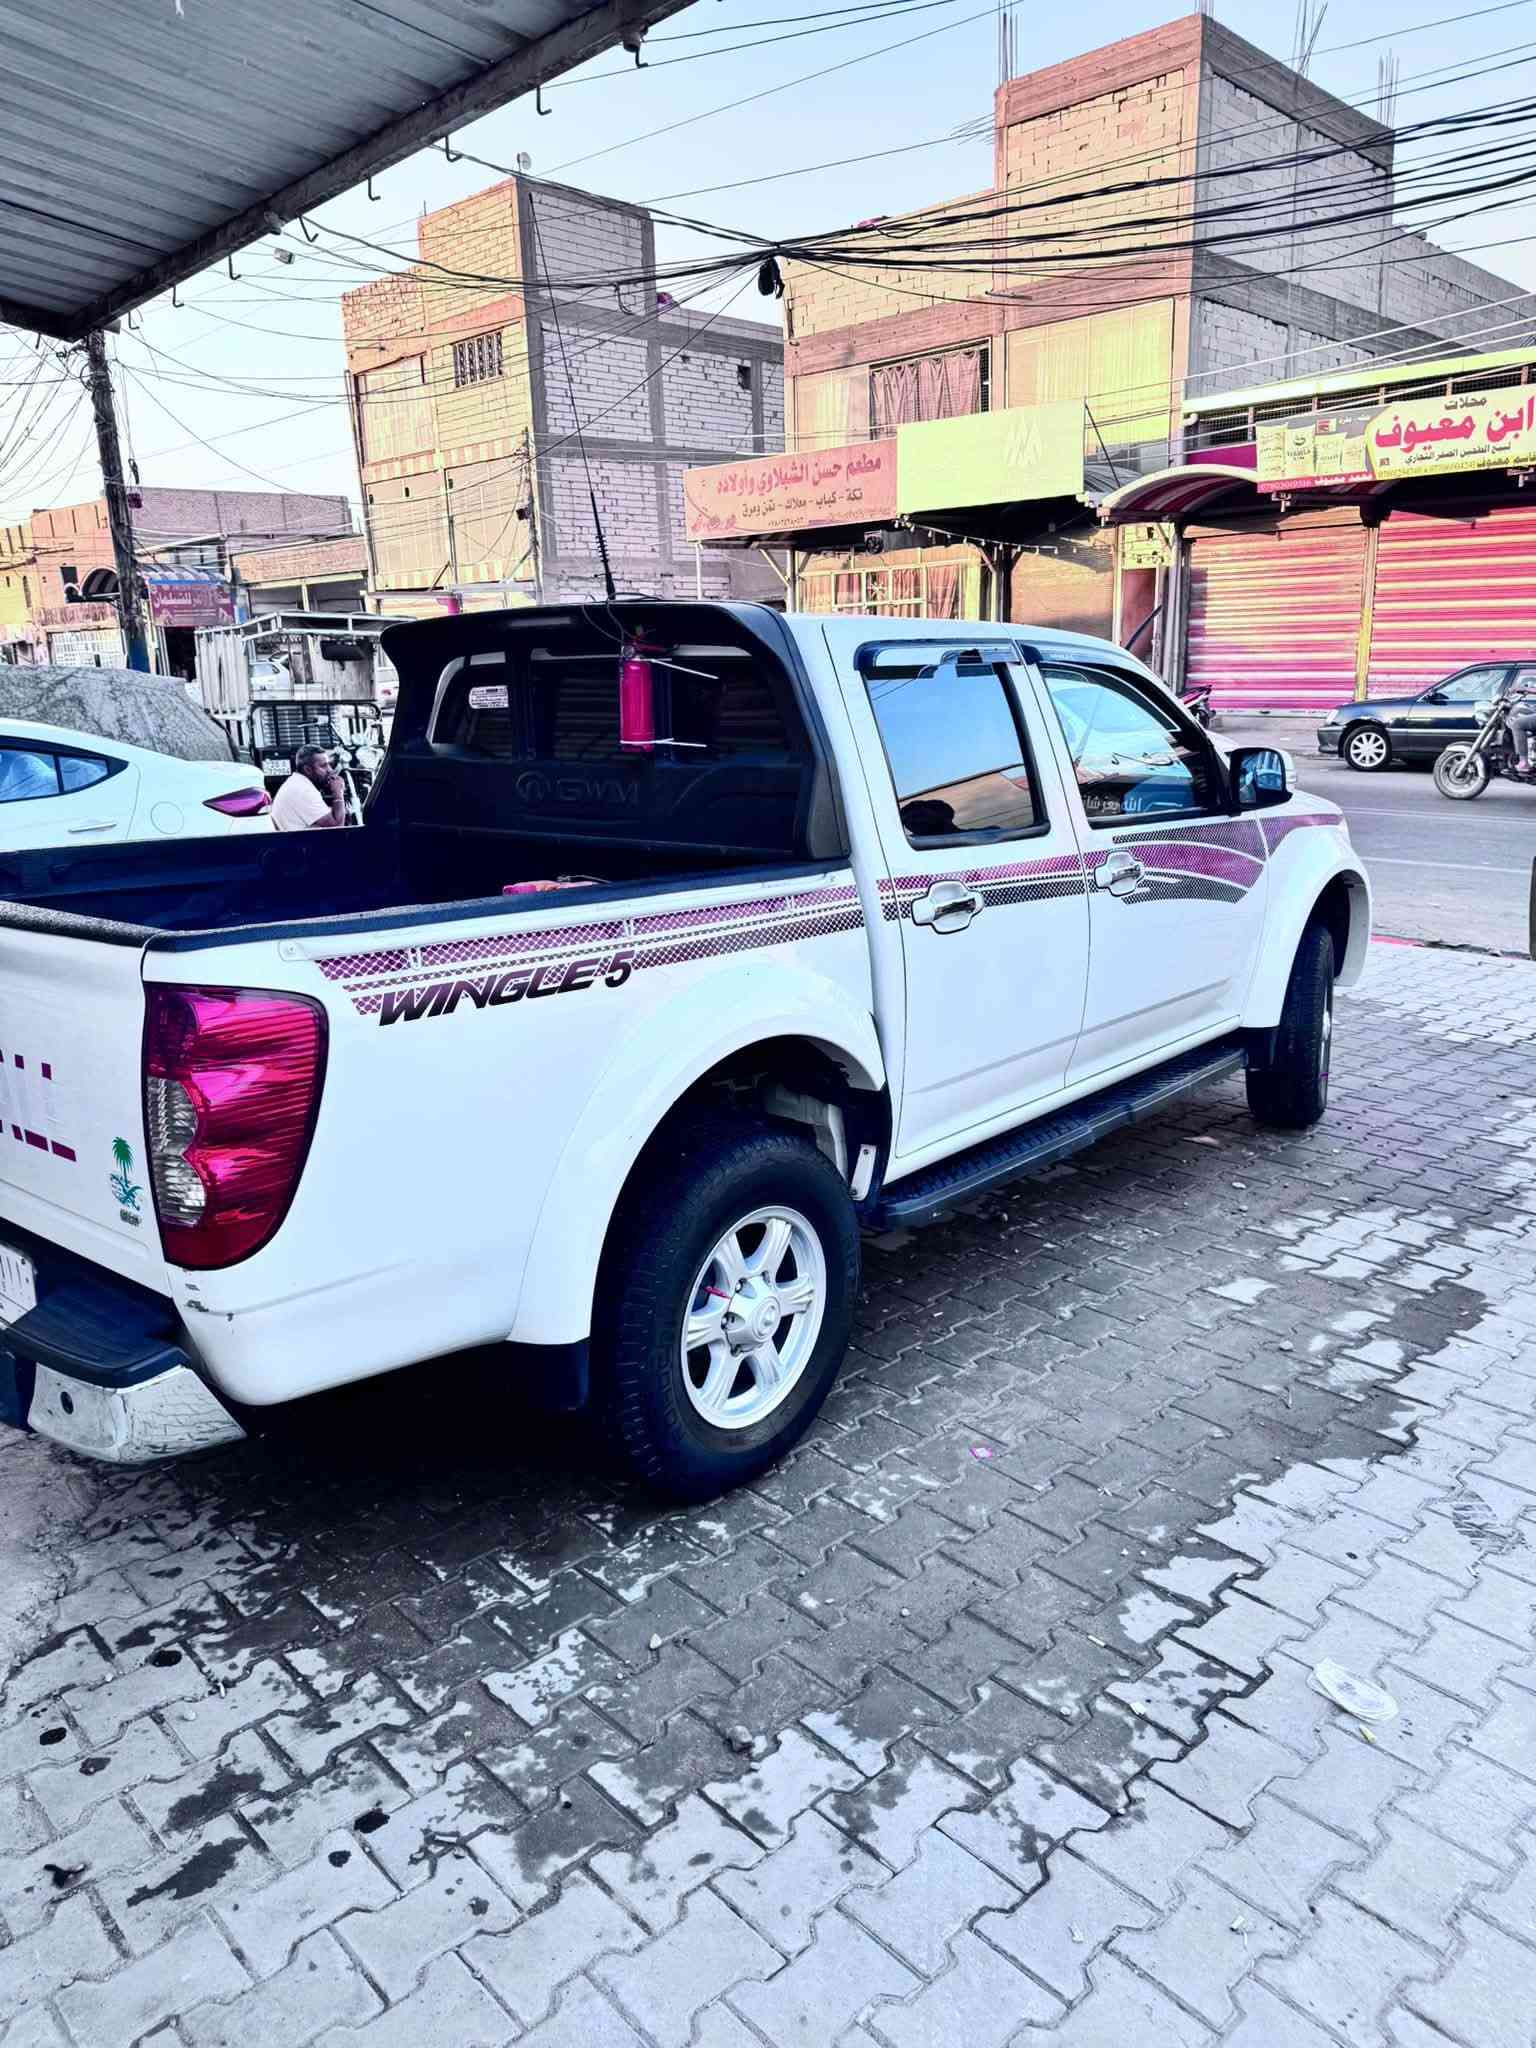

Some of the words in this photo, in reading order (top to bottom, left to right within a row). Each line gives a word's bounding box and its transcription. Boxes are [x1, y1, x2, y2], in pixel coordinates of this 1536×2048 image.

[1444, 397, 1488, 410] محلات
[1486, 396, 1535, 442] ابن
[1375, 415, 1476, 453] معيوف
[812, 462, 842, 486] حسن
[846, 453, 881, 481] مطعم
[815, 491, 838, 509] كباب
[846, 488, 863, 502] تكة
[557, 777, 640, 804] GWM
[379, 958, 600, 1026] WINGLE
[604, 950, 635, 988] 5
